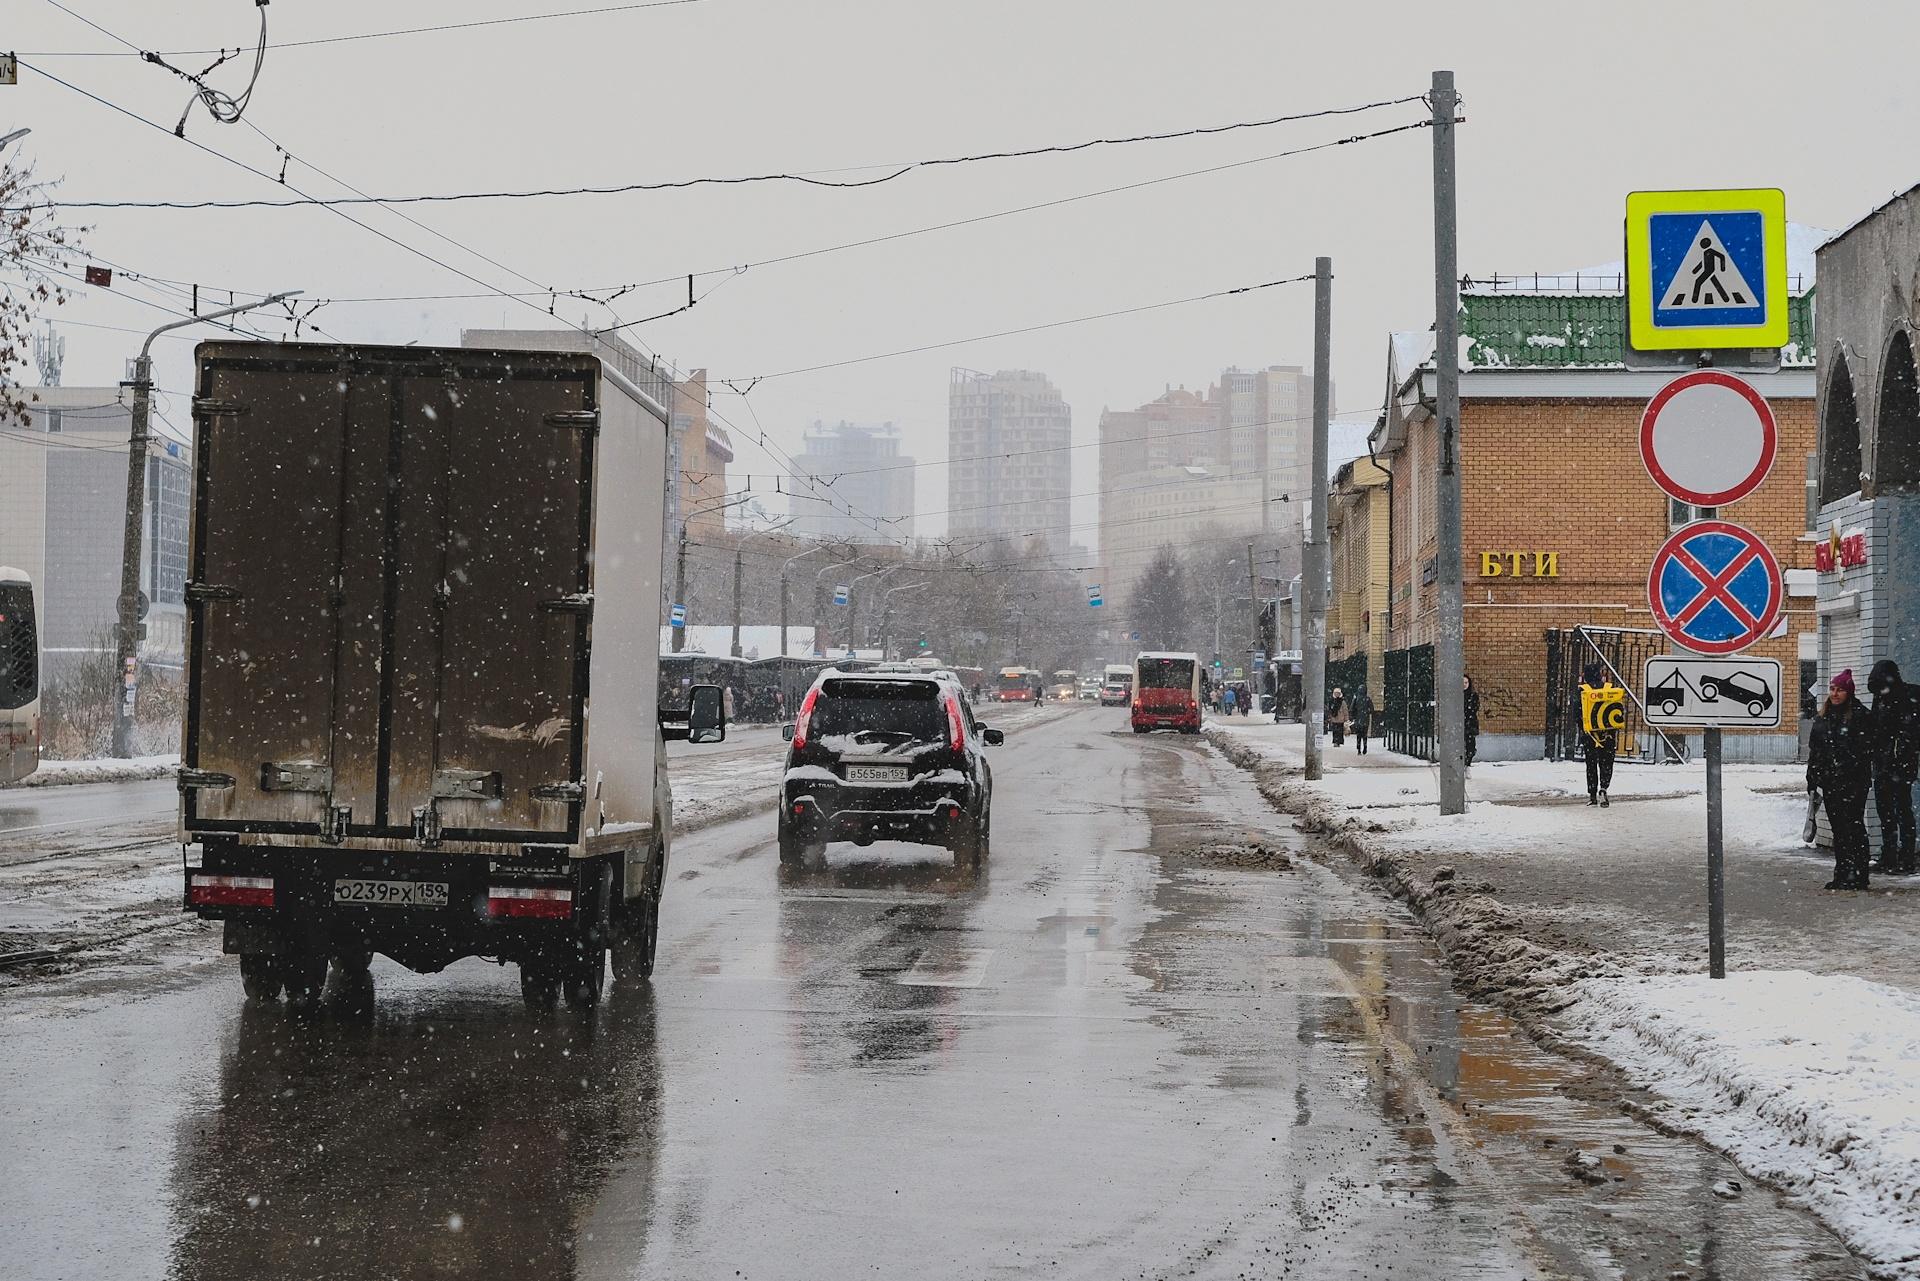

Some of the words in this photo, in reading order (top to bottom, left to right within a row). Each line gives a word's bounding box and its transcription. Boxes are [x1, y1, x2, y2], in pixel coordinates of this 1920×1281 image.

[1479, 551, 1560, 577] БТИ
[850, 768, 888, 779] В565ВВ
[890, 769, 905, 777] 159
[340, 882, 413, 902] О239РХ
[417, 883, 444, 898] 159
